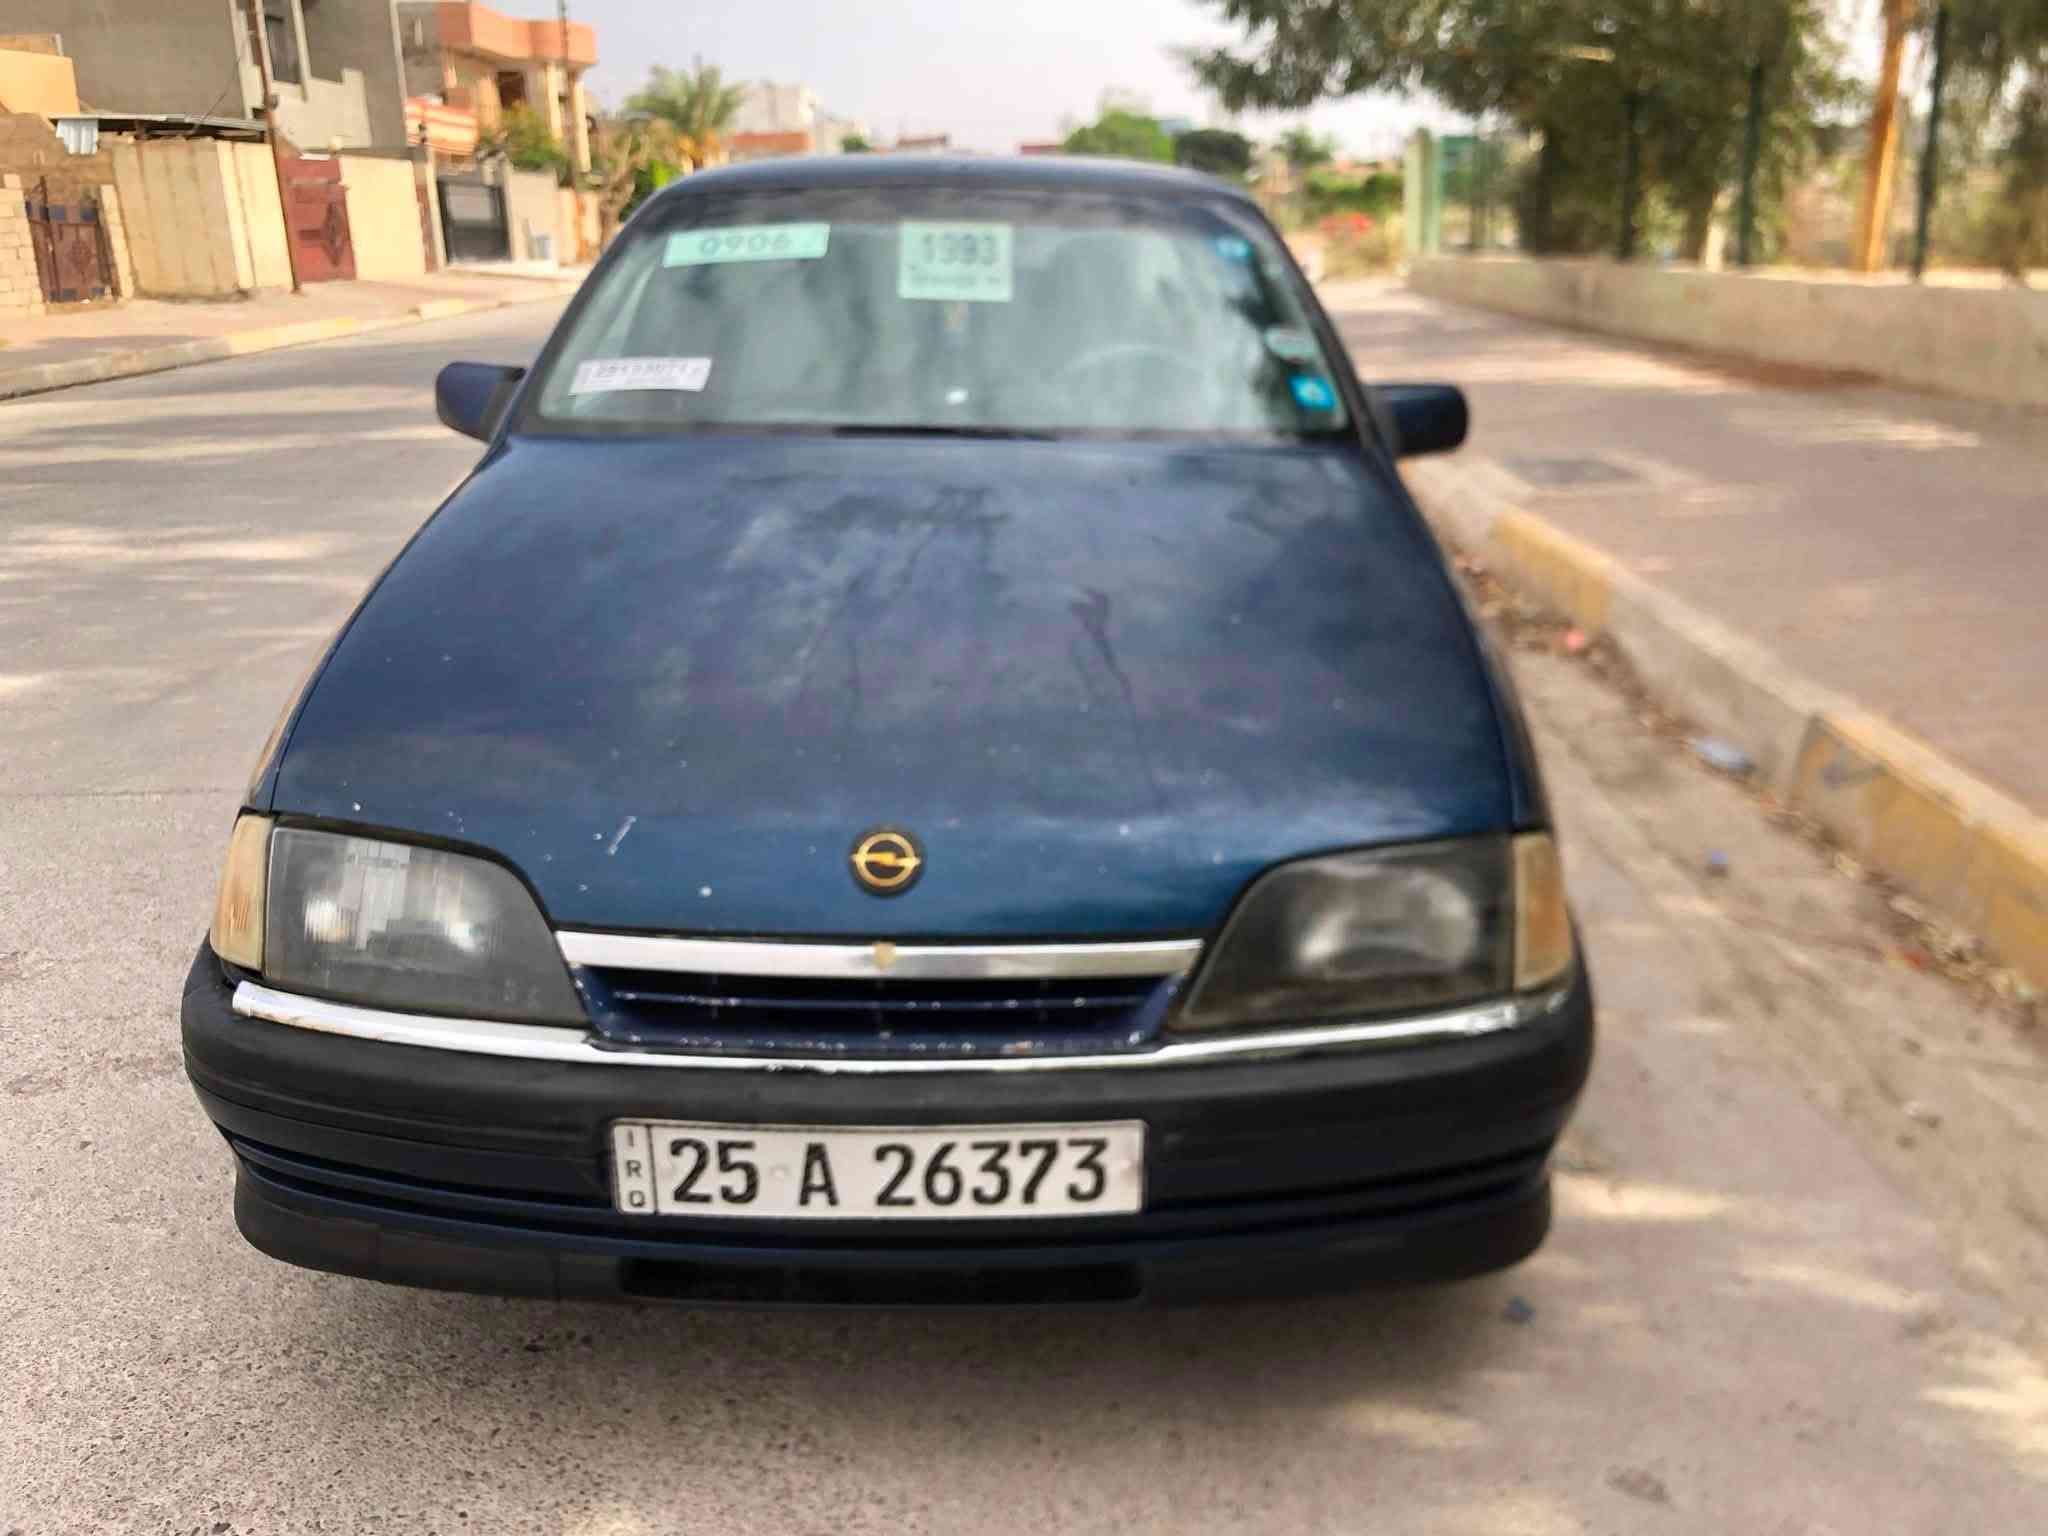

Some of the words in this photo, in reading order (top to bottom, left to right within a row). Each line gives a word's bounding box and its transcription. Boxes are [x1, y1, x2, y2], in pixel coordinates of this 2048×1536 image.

[625, 1128, 646, 1208] IRQ
[670, 1138, 759, 1204] 25
[798, 1141, 839, 1207] A
[874, 1137, 1109, 1207] 26373
